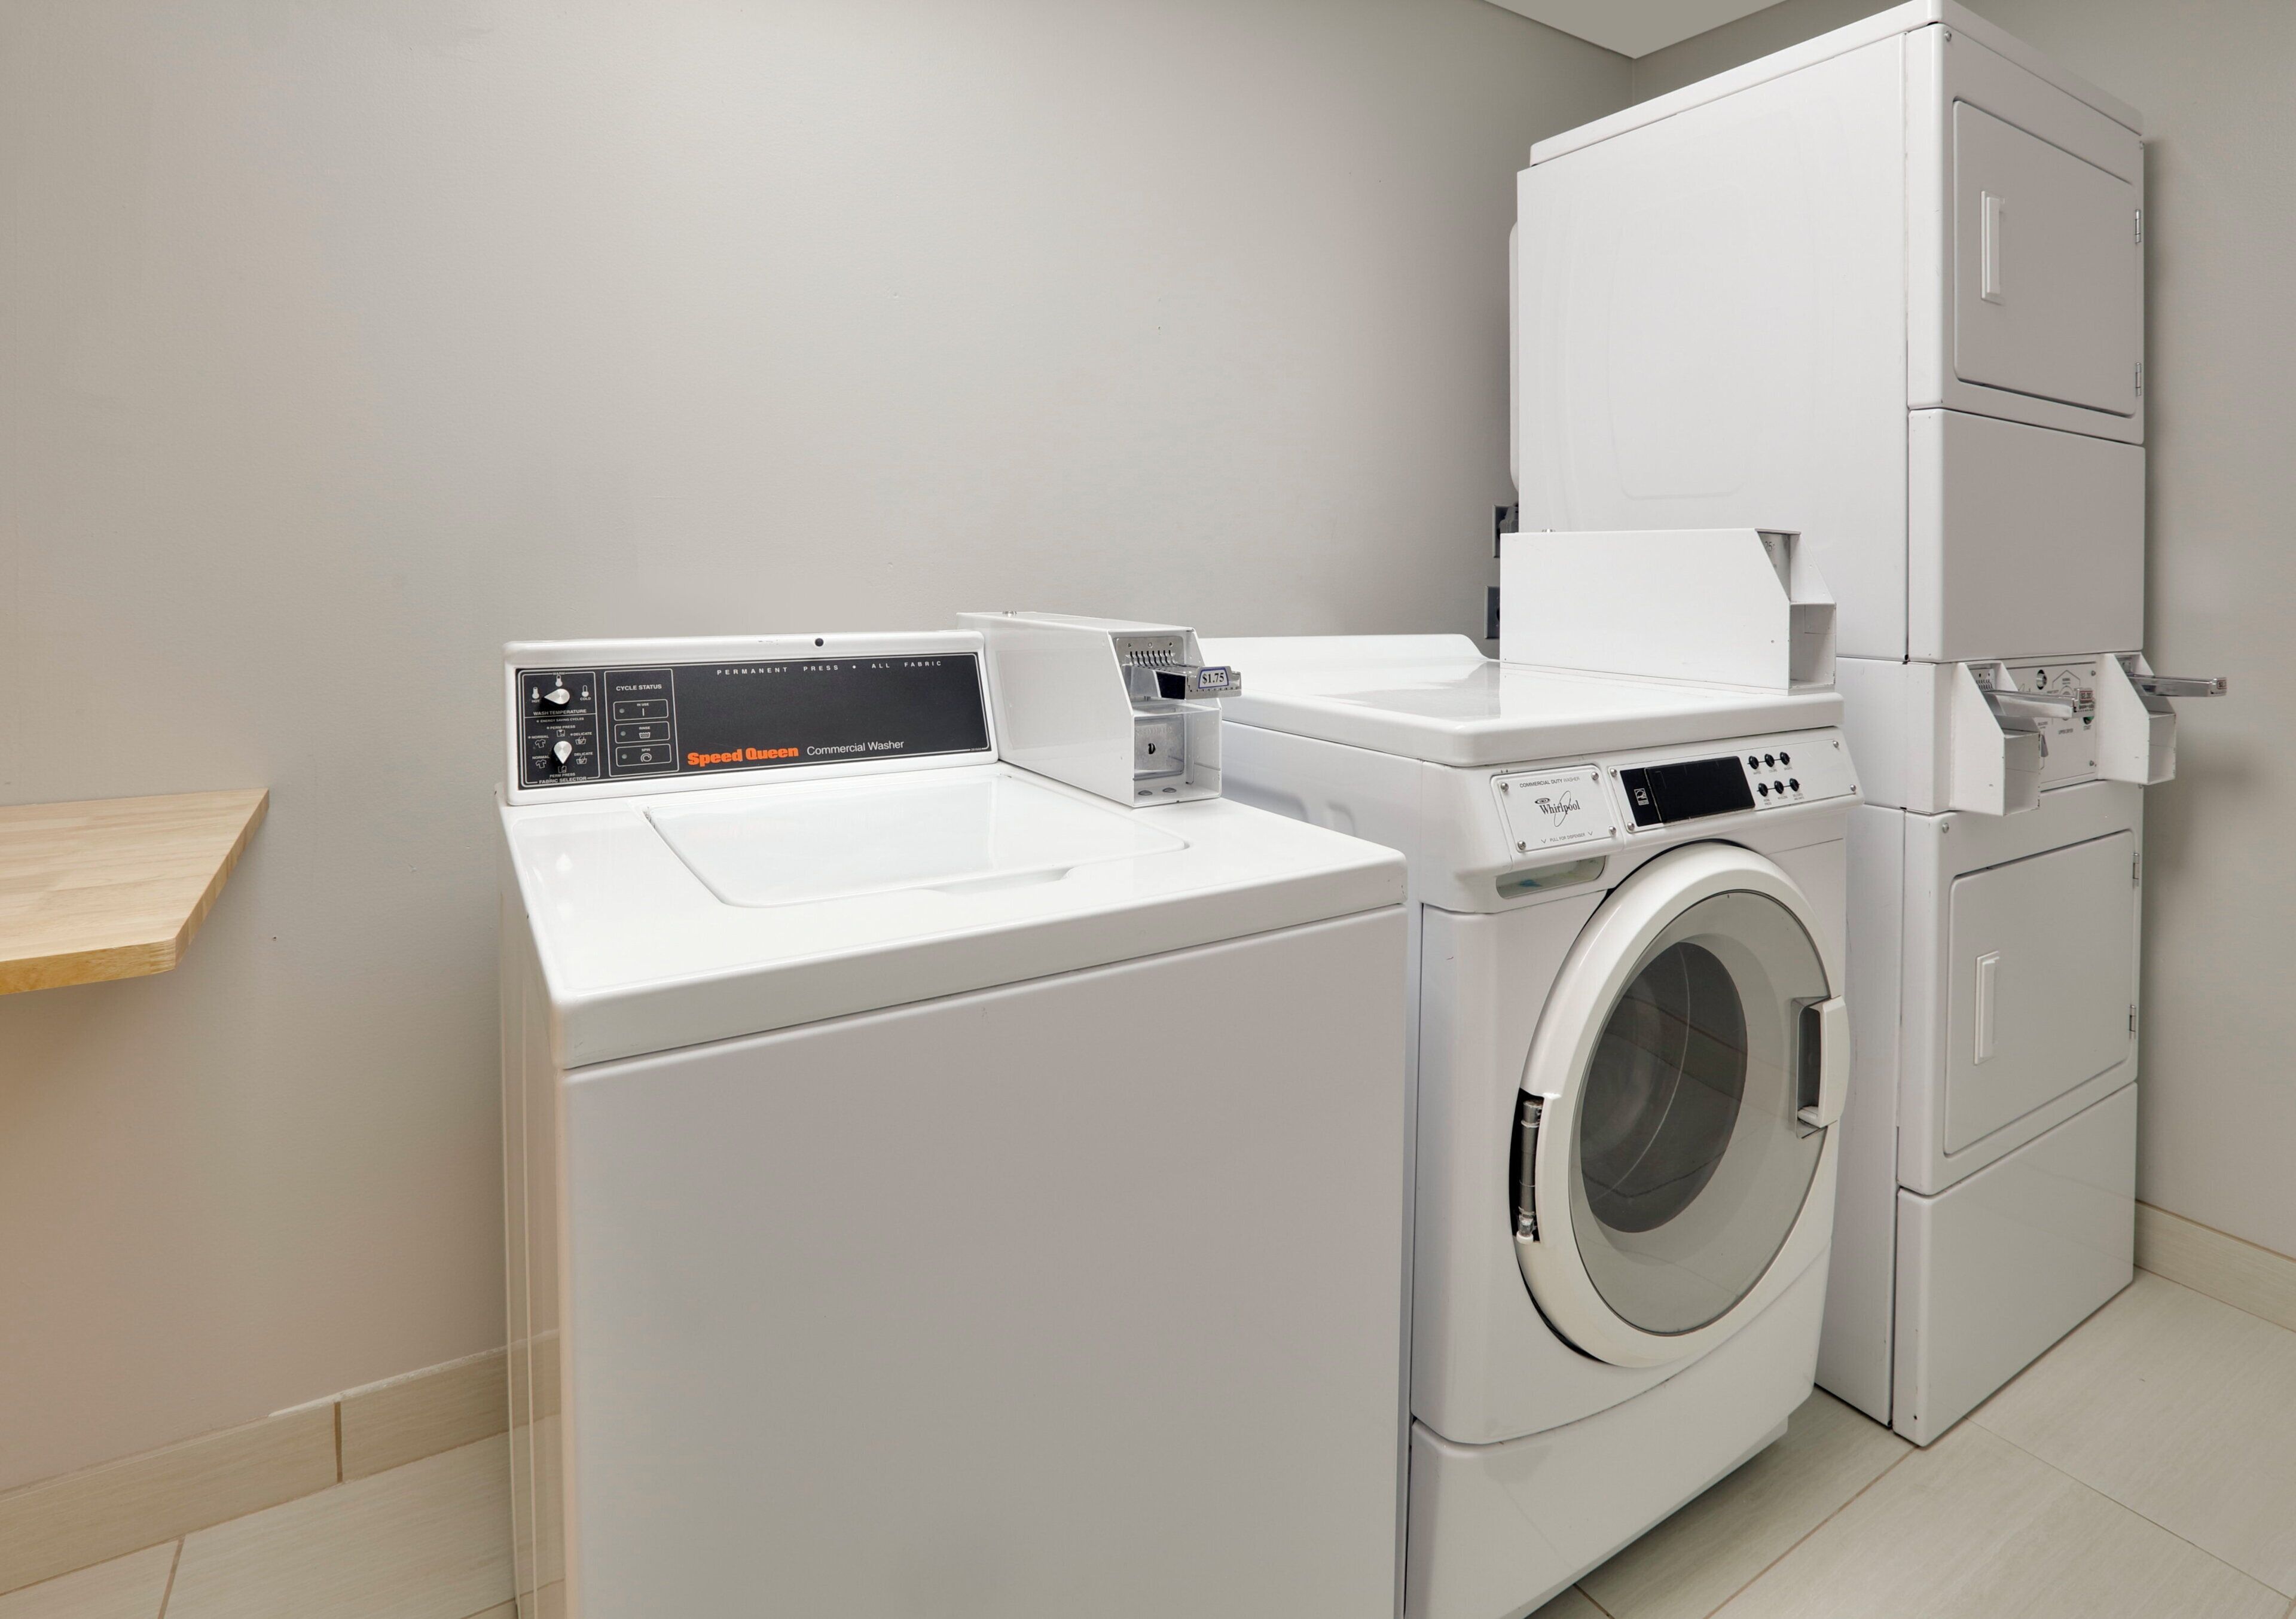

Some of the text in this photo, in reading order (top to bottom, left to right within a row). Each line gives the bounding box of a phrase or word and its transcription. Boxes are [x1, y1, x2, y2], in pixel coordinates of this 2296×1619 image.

[717, 667, 787, 676] PERMANENT
[1202, 672, 1225, 685] $1.75
[807, 741, 904, 756] Commercial Washer
[688, 747, 799, 767] Speed Queen
[1539, 800, 1580, 815] Whirlpool
